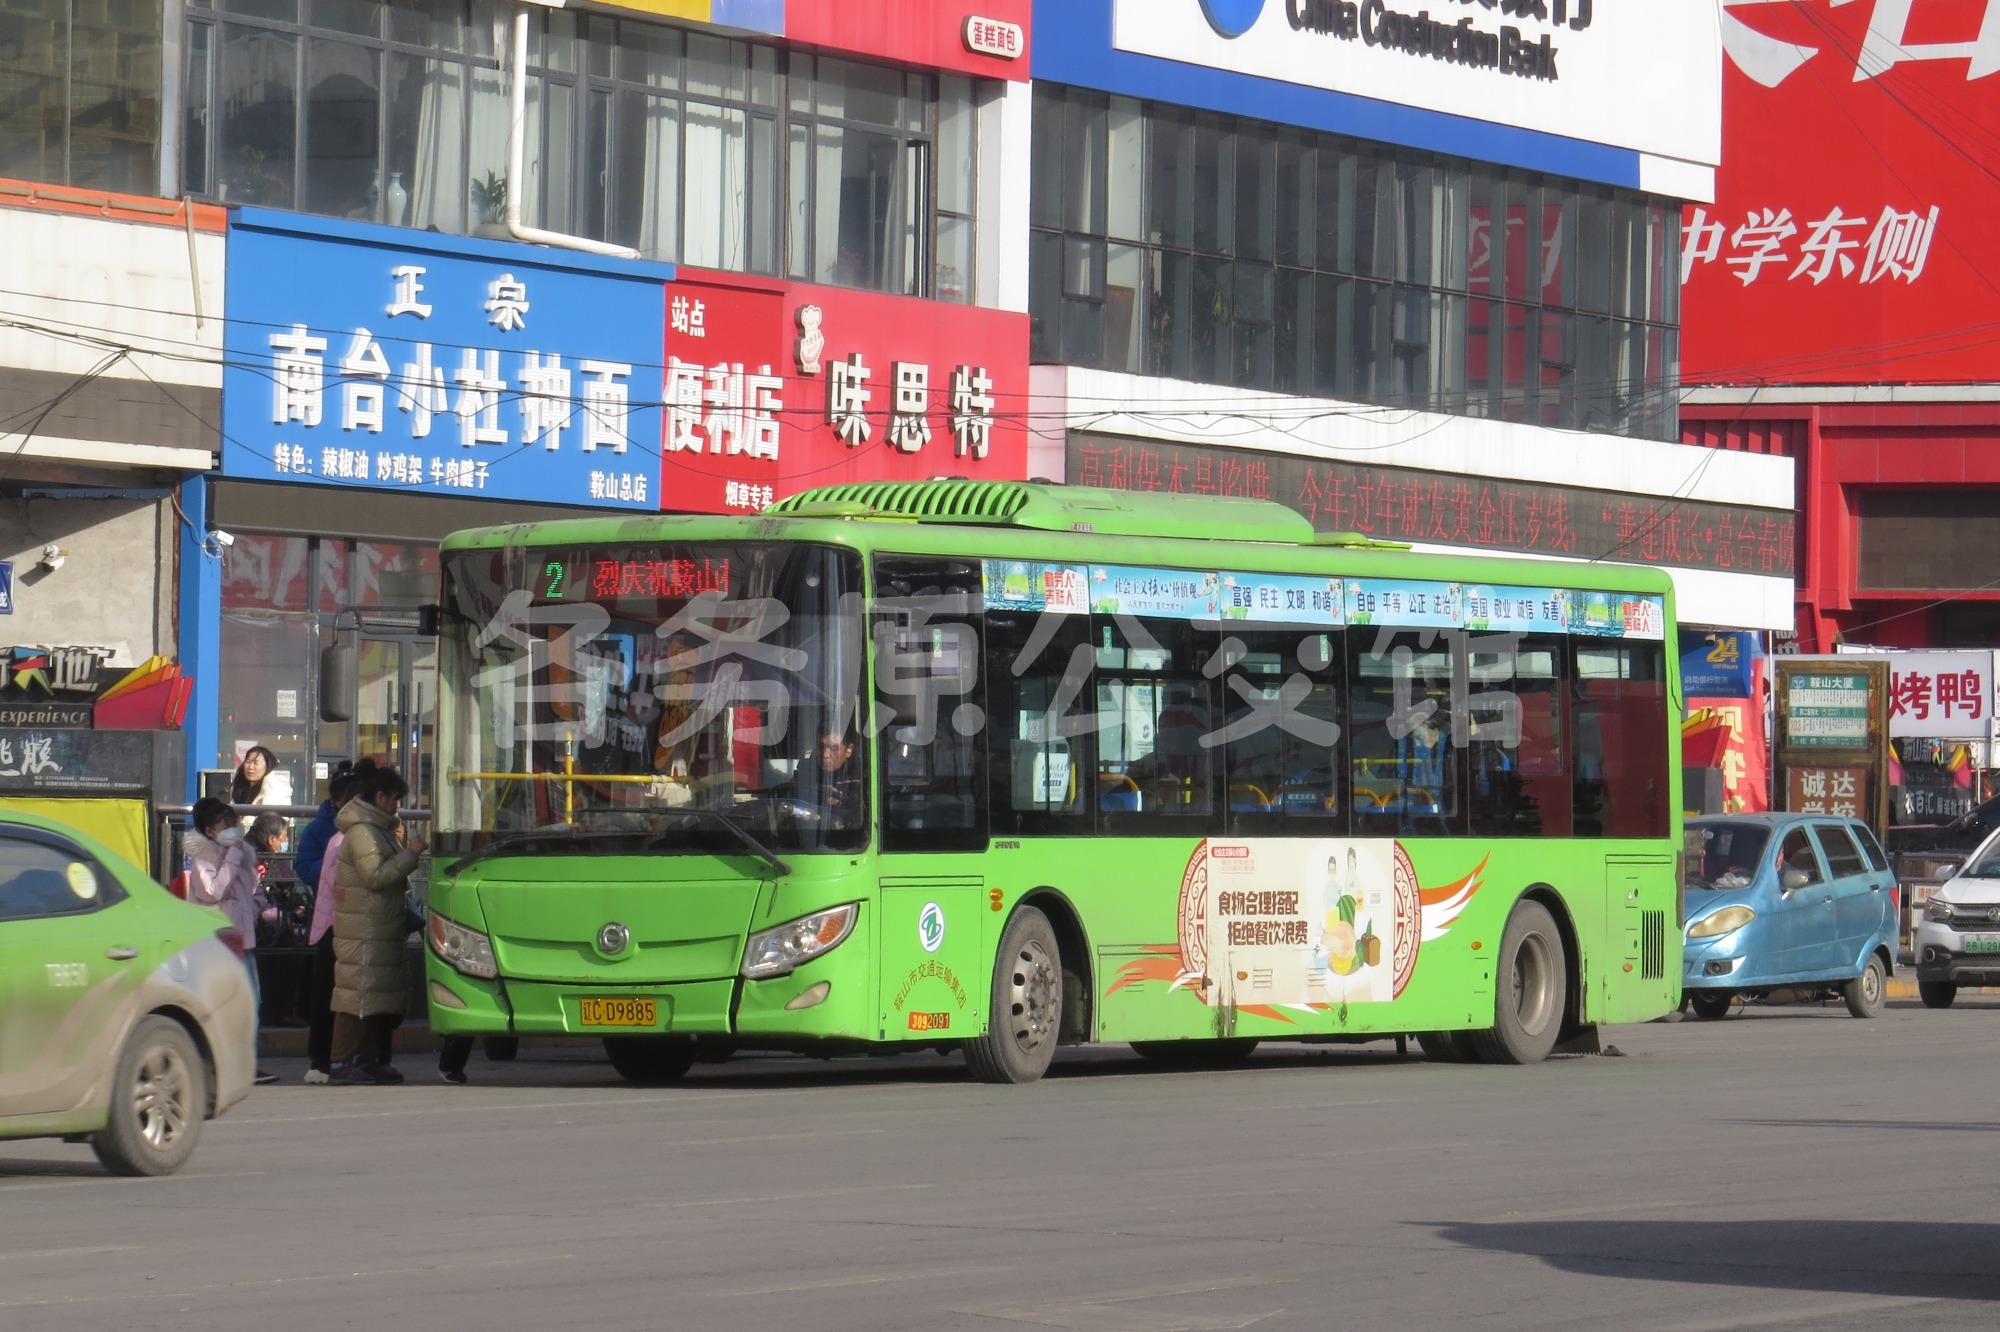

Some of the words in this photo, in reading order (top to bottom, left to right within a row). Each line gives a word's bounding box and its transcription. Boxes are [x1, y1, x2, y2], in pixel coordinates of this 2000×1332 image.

[974, 22, 1015, 51] 蛋糕面包
[1286, 0, 1360, 42] China
[1360, 0, 1499, 72] Construction
[1500, 25, 1558, 83] Bank
[387, 264, 530, 332] 正宗
[671, 296, 705, 337] 站点
[270, 322, 632, 454] 南台小杜抻面
[663, 355, 784, 460] 便利店
[824, 352, 995, 459] 味思特
[321, 447, 369, 479] 辣椒油
[376, 452, 422, 484] 炒鸡架
[590, 470, 647, 502] 鞍山总店
[725, 480, 773, 511] 烟草专卖
[546, 562, 563, 598] 2
[1044, 571, 1076, 588] 勤劳人
[1114, 575, 1199, 599] 社会主义核心价值观
[1045, 589, 1075, 606] 吉祥人
[1232, 586, 1252, 608] 富强
[1260, 587, 1279, 609] 民主
[1286, 589, 1305, 610] 文明
[1312, 590, 1331, 612] 和谐
[1357, 592, 1375, 612] 自由
[1383, 592, 1401, 614] 平等
[1408, 593, 1426, 614] 公正
[1433, 594, 1450, 615] 法治
[1471, 597, 1488, 617] 爱国
[1494, 598, 1511, 618] 敬业
[1517, 600, 1534, 620] 诚信
[1542, 601, 1559, 621] 友善
[1622, 601, 1652, 617] 勤劳人
[1623, 616, 1650, 632] 吉祥人
[1706, 637, 1739, 662] 24
[1810, 677, 1854, 689] 鞍山大厦
[1889, 669, 1982, 720] 烤鸭
[1801, 771, 1855, 798] 诚达
[1218, 891, 1298, 915] 食物合理搭配
[1228, 921, 1307, 946] 拒绝餐饮浪费
[894, 960, 967, 1012] 鞍山市交通运输集团
